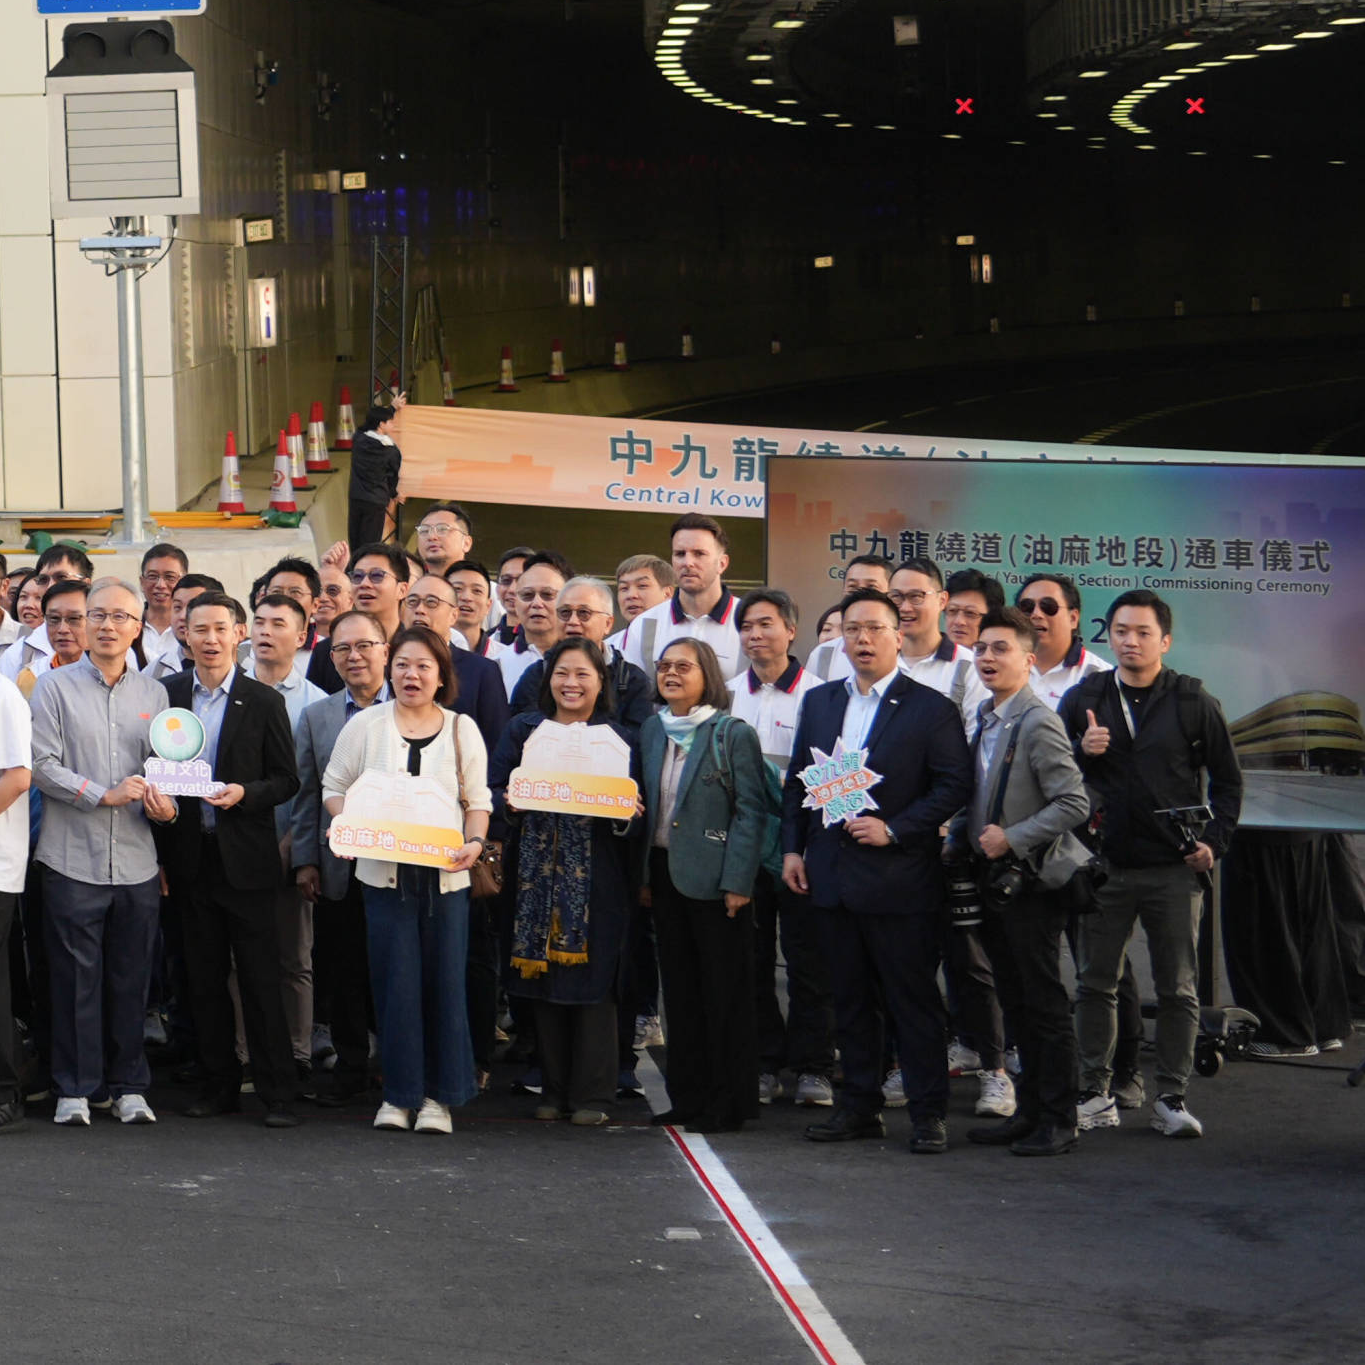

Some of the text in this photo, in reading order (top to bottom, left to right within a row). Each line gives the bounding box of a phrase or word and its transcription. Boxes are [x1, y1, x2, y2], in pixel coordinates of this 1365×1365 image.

[606, 482, 701, 506] Central
[828, 528, 1331, 574] 中九龍繞道(油麻地段)通車儀式
[1003, 572, 1026, 585] Yau
[1078, 573, 1130, 587] Section
[1142, 575, 1253, 594] Commissioning
[1256, 578, 1330, 596] Ceremony
[512, 777, 635, 809] 油麻地 Yau Ma Tei
[334, 825, 396, 850] 油麻地
[399, 838, 420, 853] Yau
[422, 843, 441, 856] Ma
